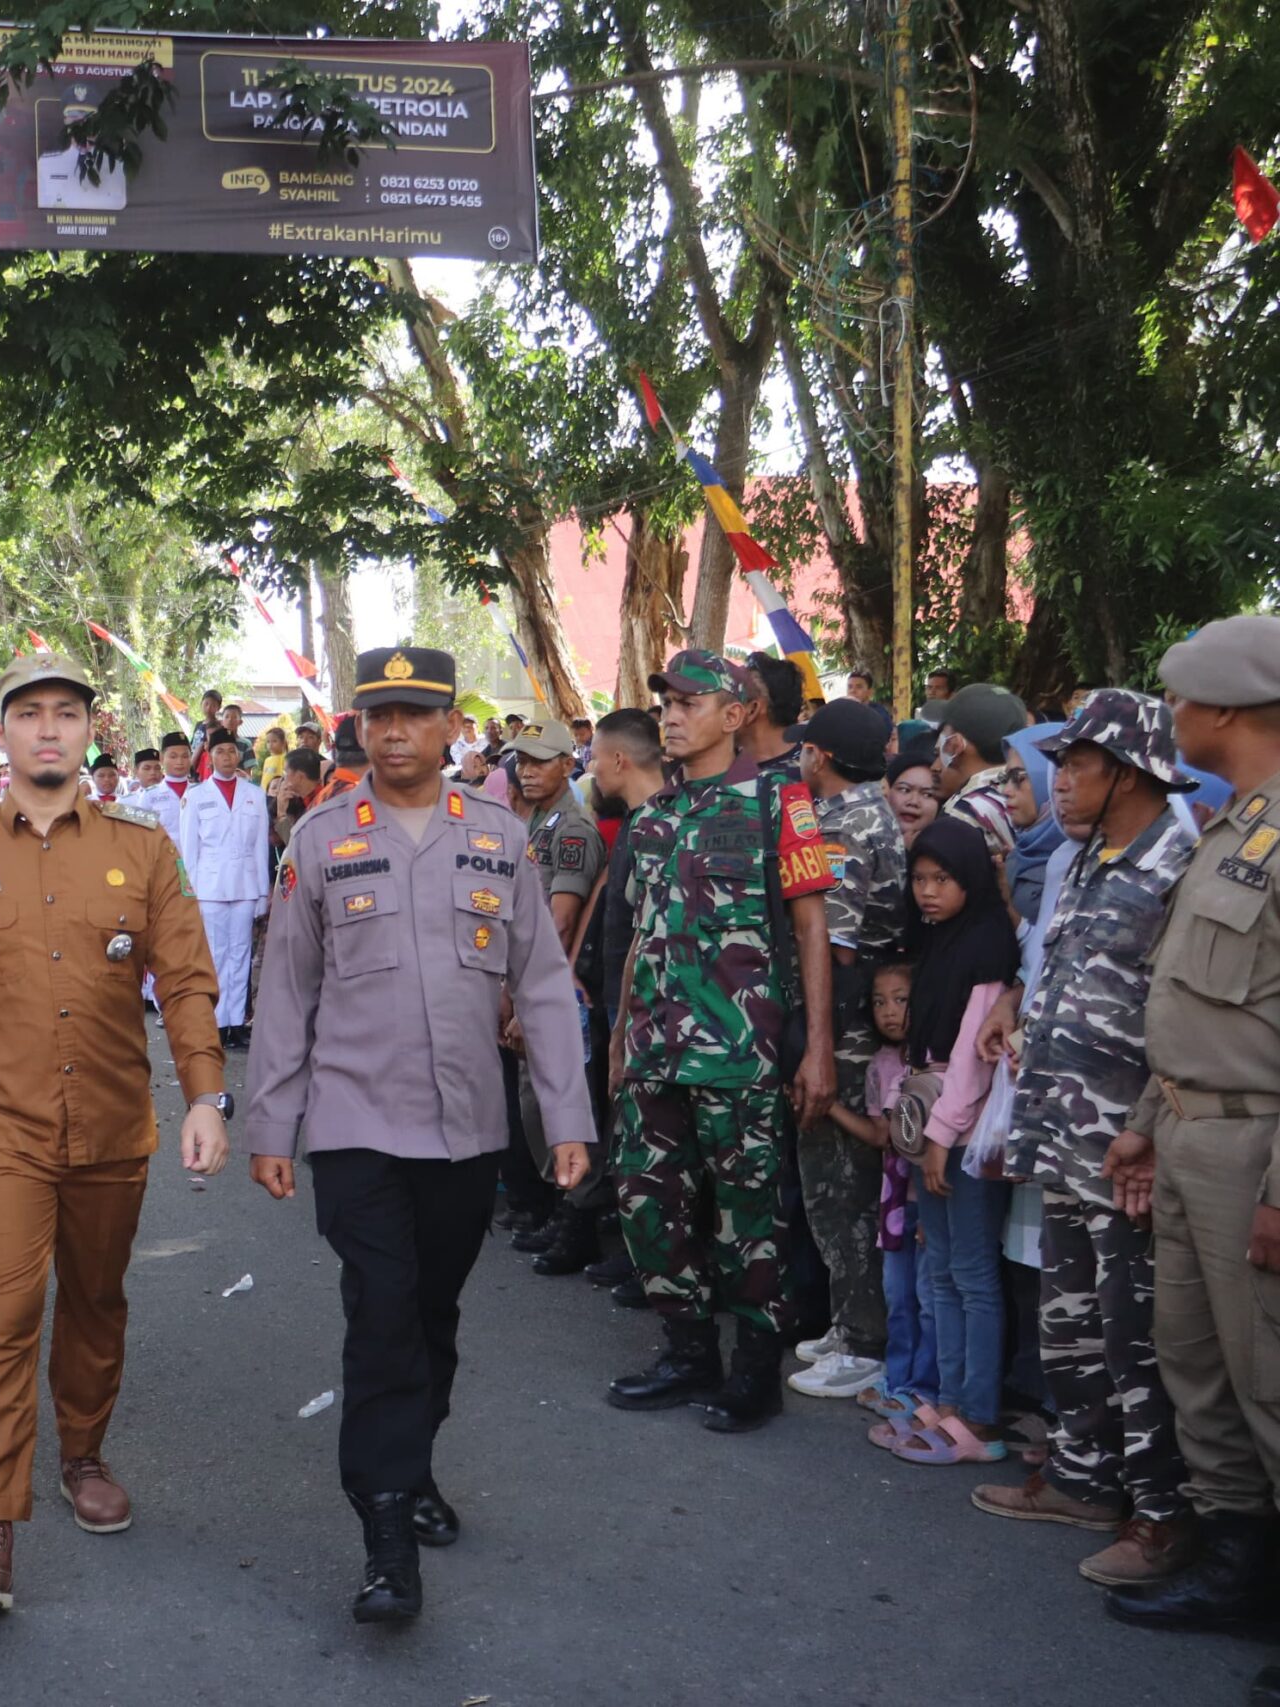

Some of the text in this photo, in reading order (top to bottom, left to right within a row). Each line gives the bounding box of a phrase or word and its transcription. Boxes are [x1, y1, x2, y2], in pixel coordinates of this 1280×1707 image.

[402, 77, 455, 96] 2024
[229, 90, 278, 109] LAP.
[230, 173, 265, 187] INFO
[279, 171, 354, 187] BAMBANG
[380, 176, 410, 189] 0821
[414, 178, 445, 190] 6253
[448, 179, 479, 192] 0120
[279, 188, 340, 203] SYAHRIL
[380, 193, 411, 205] 0821
[414, 194, 447, 207] 6473
[450, 195, 482, 208] 5455
[268, 223, 443, 245] #ExtrakanHarimu
[491, 233, 508, 243] 18+
[455, 854, 515, 879] POLRI
